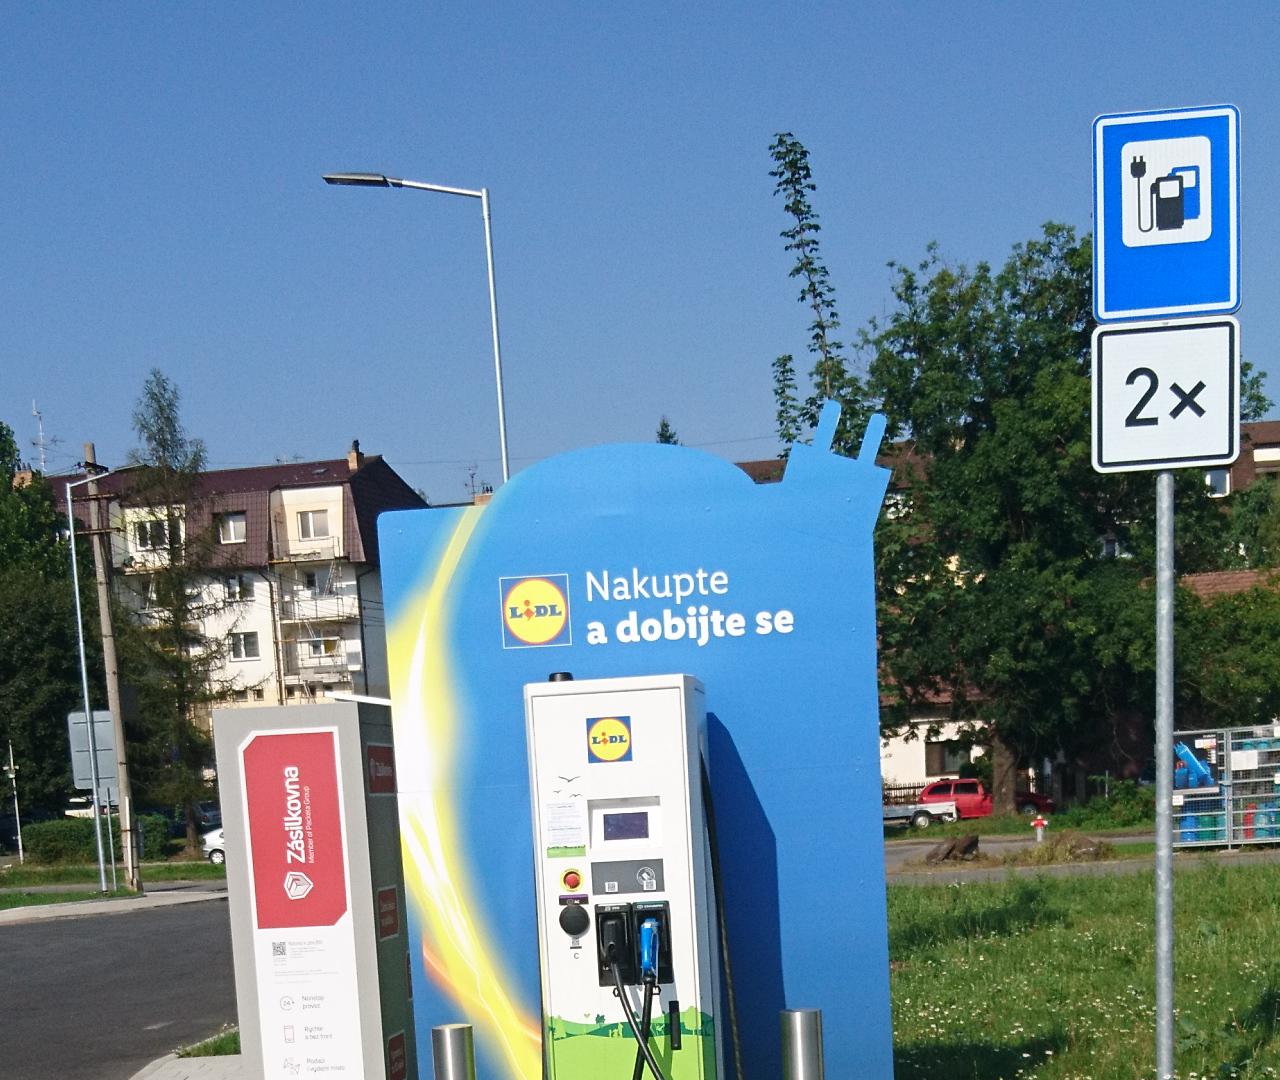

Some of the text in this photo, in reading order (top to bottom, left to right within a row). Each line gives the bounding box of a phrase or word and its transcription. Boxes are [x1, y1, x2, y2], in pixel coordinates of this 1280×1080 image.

[585, 567, 729, 605] Nakupte
[586, 605, 795, 647] a dobijte se
[283, 766, 306, 864] Zásilkovna
